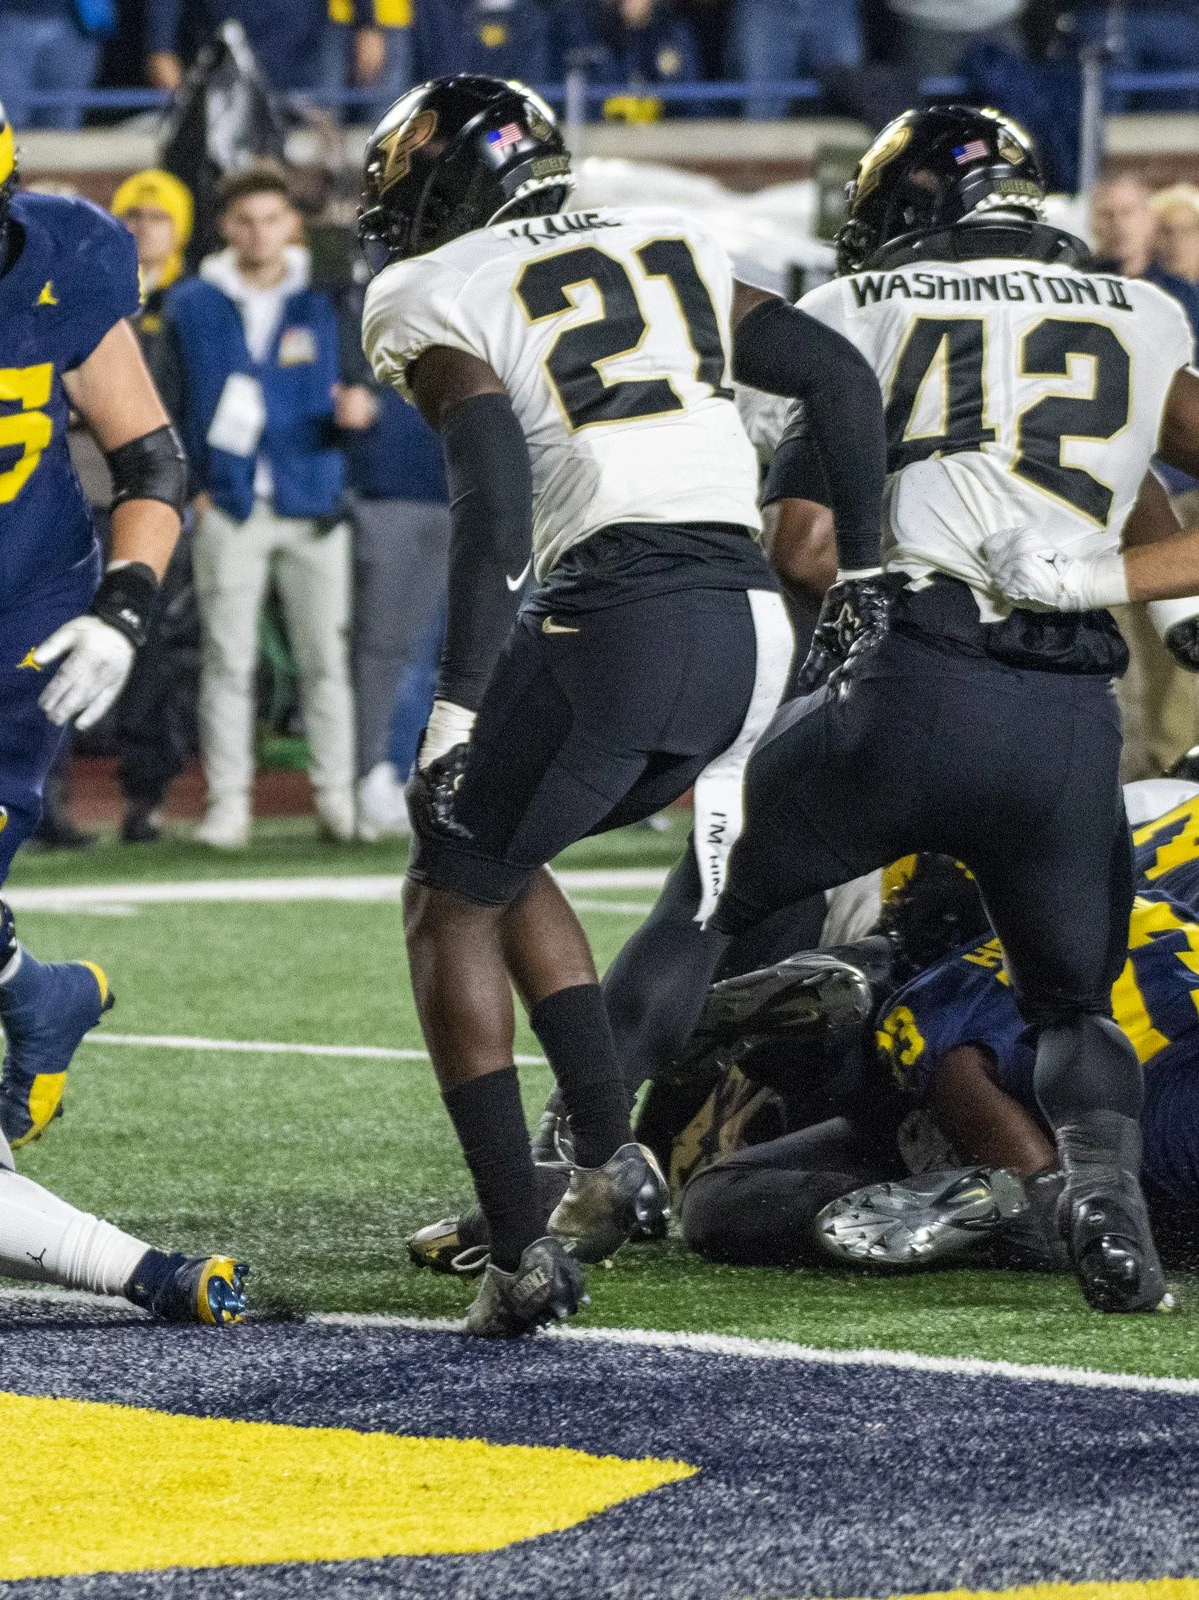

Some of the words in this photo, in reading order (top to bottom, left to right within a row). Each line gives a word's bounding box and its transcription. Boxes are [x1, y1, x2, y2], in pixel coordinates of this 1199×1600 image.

[510, 235, 736, 437] 21
[849, 271, 1101, 308] WASHINGTON
[881, 313, 1134, 530] 42
